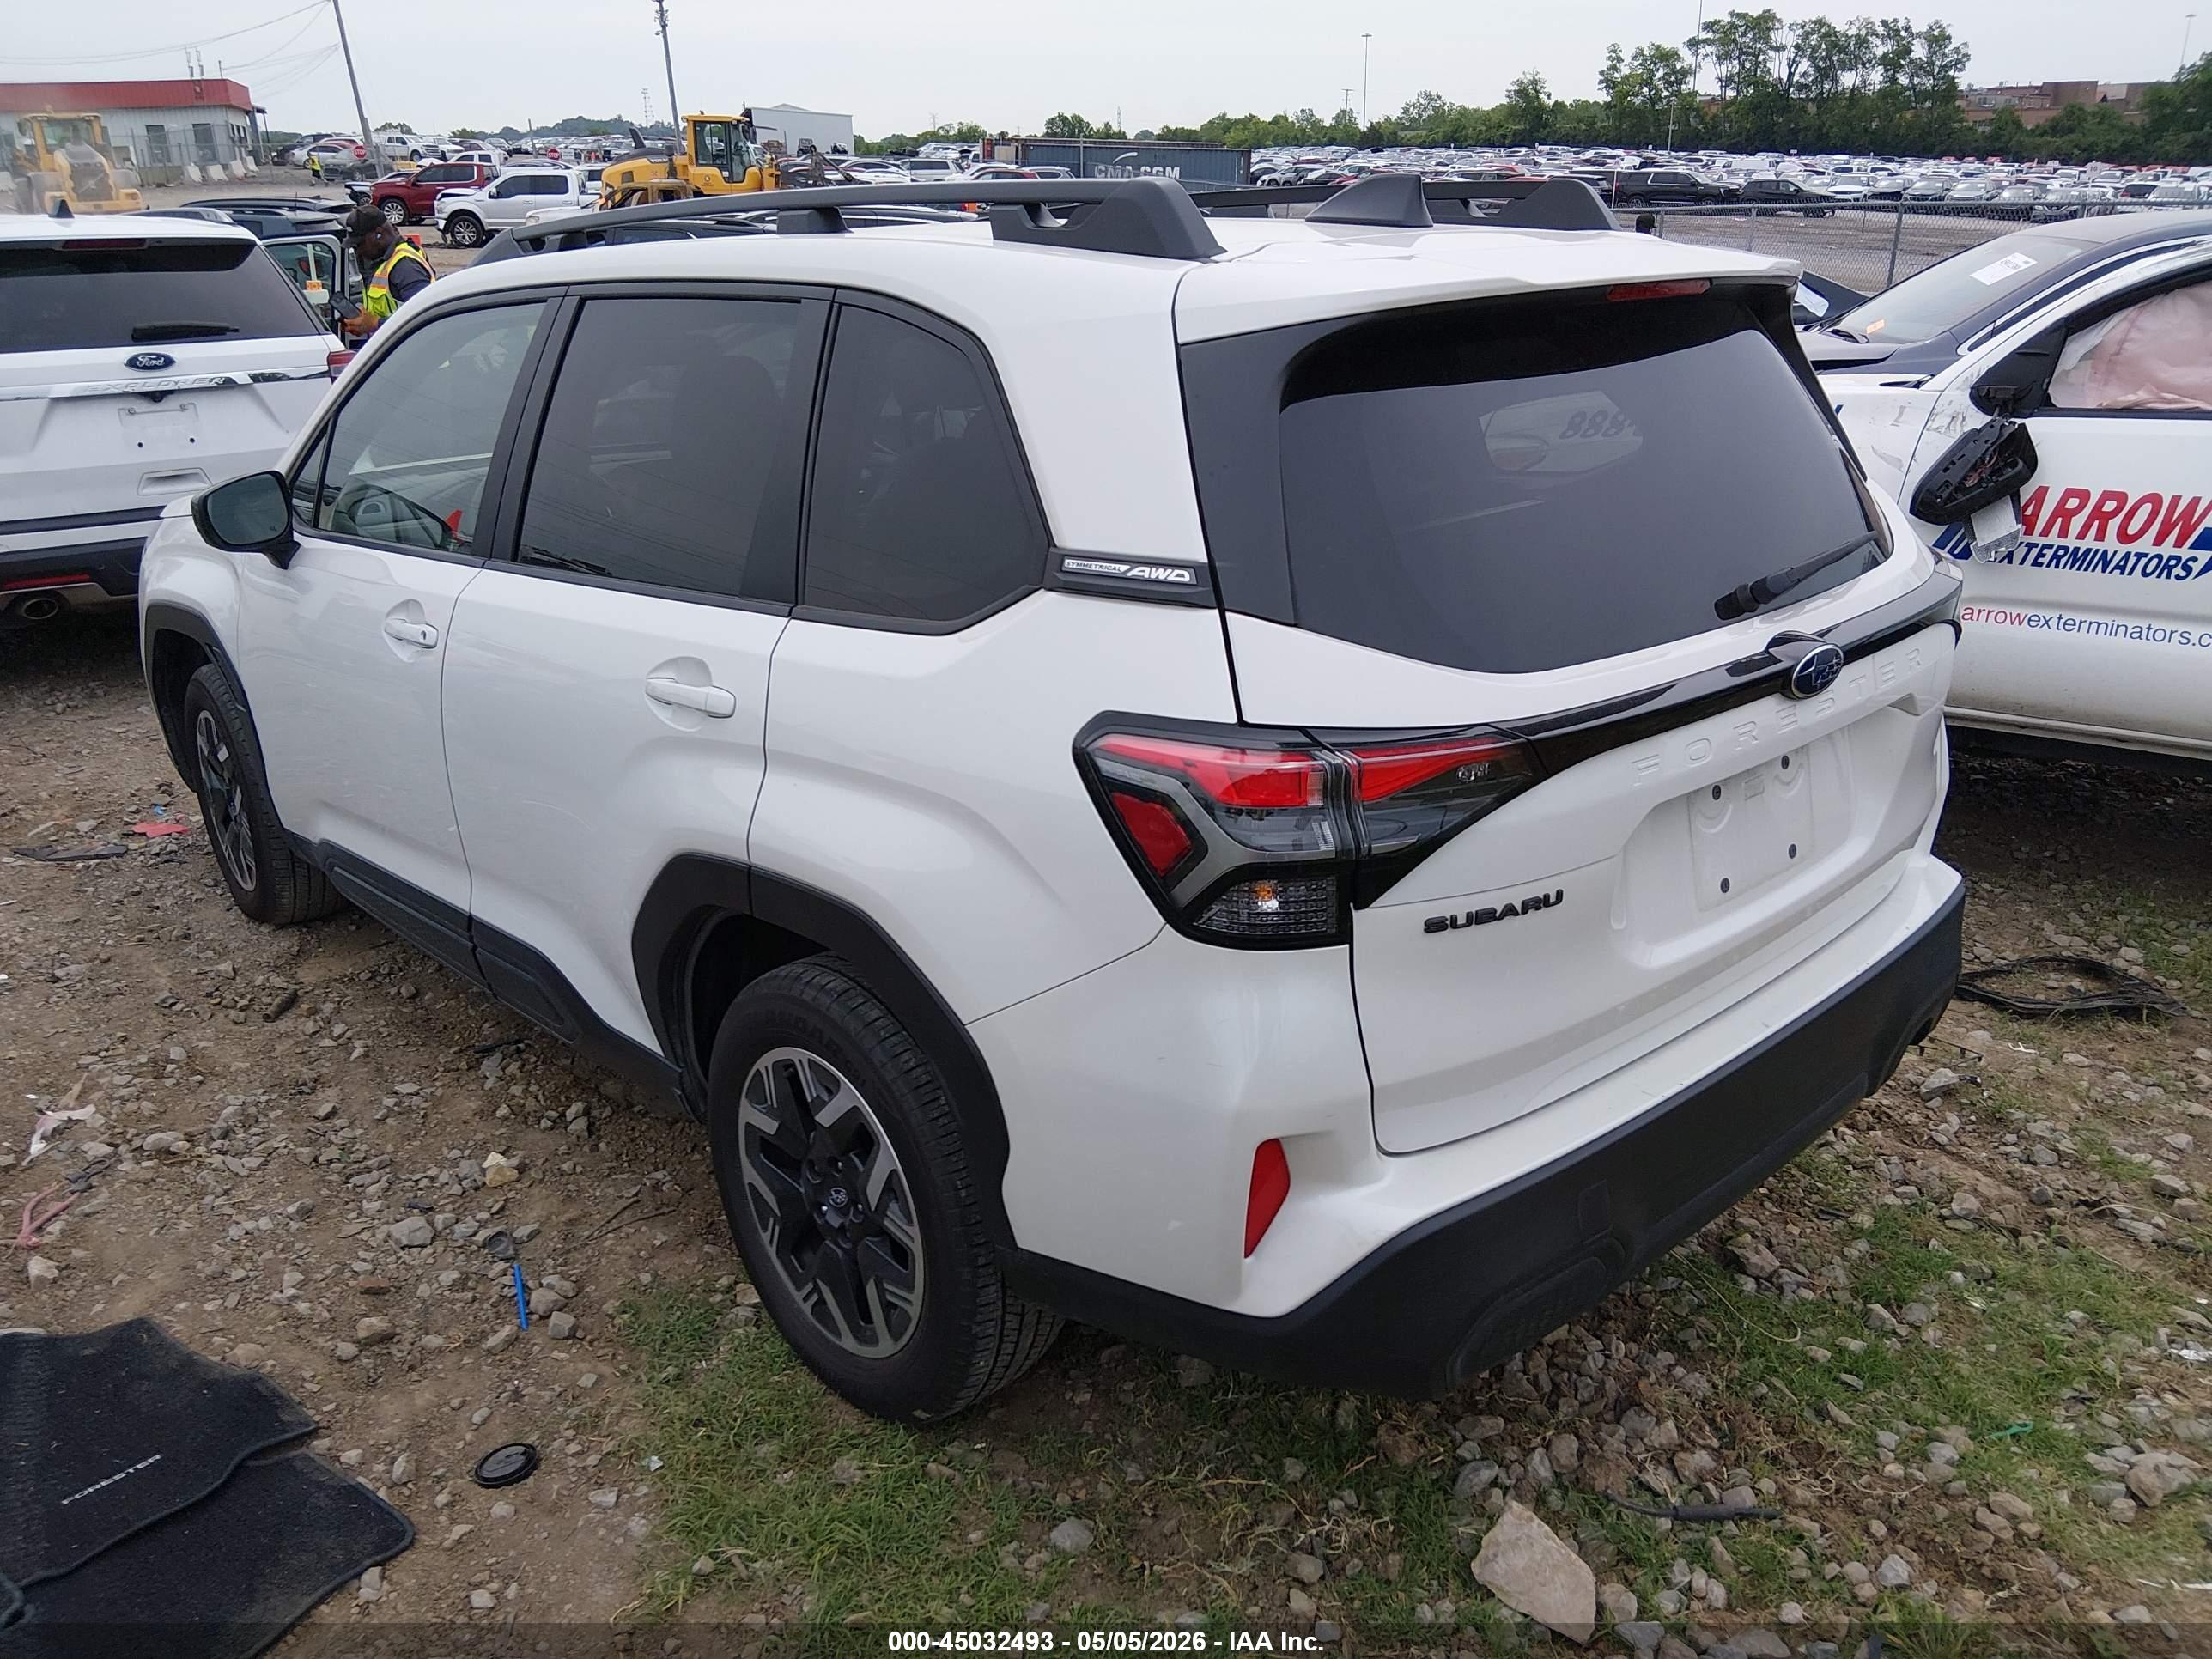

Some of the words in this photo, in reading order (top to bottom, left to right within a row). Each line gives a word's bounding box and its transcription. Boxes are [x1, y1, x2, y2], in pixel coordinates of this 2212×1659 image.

[1094, 165, 1133, 179] CMA
[1139, 166, 1182, 179] CGM
[137, 355, 166, 368] Ford
[83, 377, 226, 393] EXPLORER
[2020, 485, 2212, 550] ARROW
[1065, 560, 1123, 573] SYMMETRICAL
[1126, 566, 1190, 582] AWD
[1630, 647, 1923, 787] FORESTER
[1423, 888, 1565, 934] SUBARU
[61, 1454, 162, 1505] FORESTER
